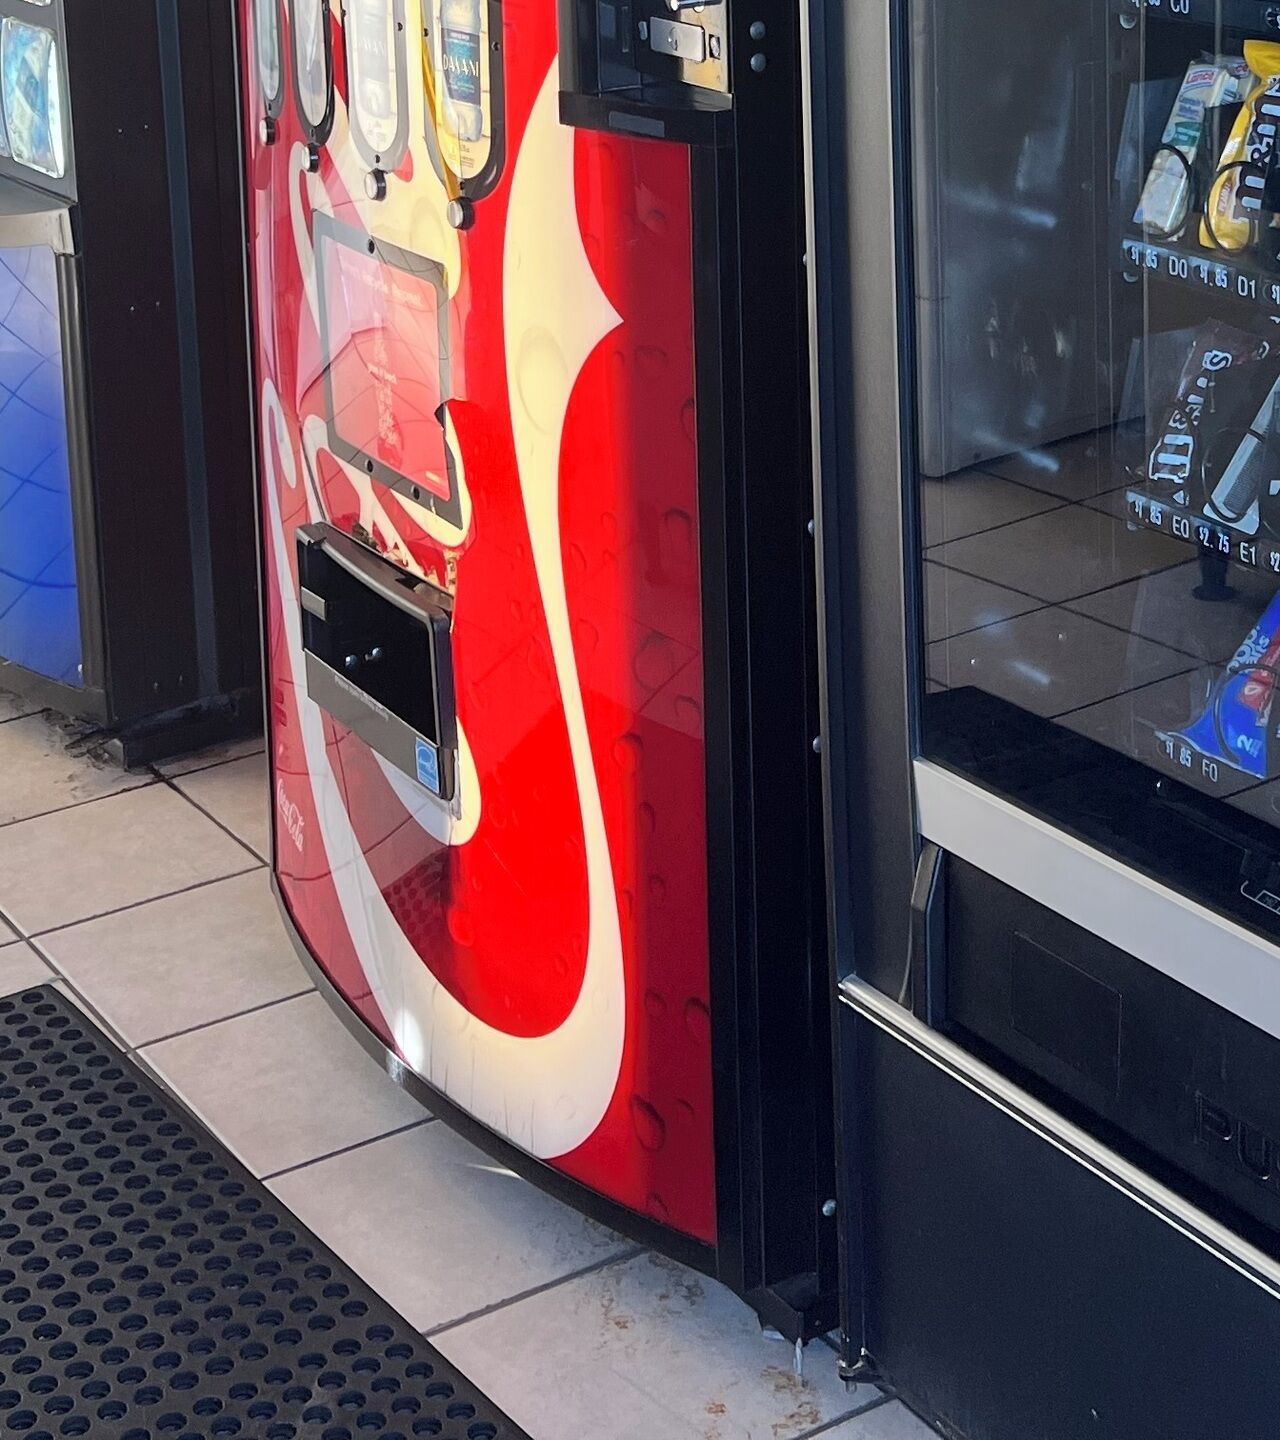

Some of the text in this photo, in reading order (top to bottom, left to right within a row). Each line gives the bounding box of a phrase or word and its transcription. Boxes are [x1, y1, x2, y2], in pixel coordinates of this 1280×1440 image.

[443, 53, 479, 77] DASANI
[1169, 255, 1188, 279] D0
[1238, 275, 1257, 299] D1
[1173, 517, 1190, 539] E0
[1240, 542, 1257, 566] E1
[1202, 760, 1217, 783] F0
